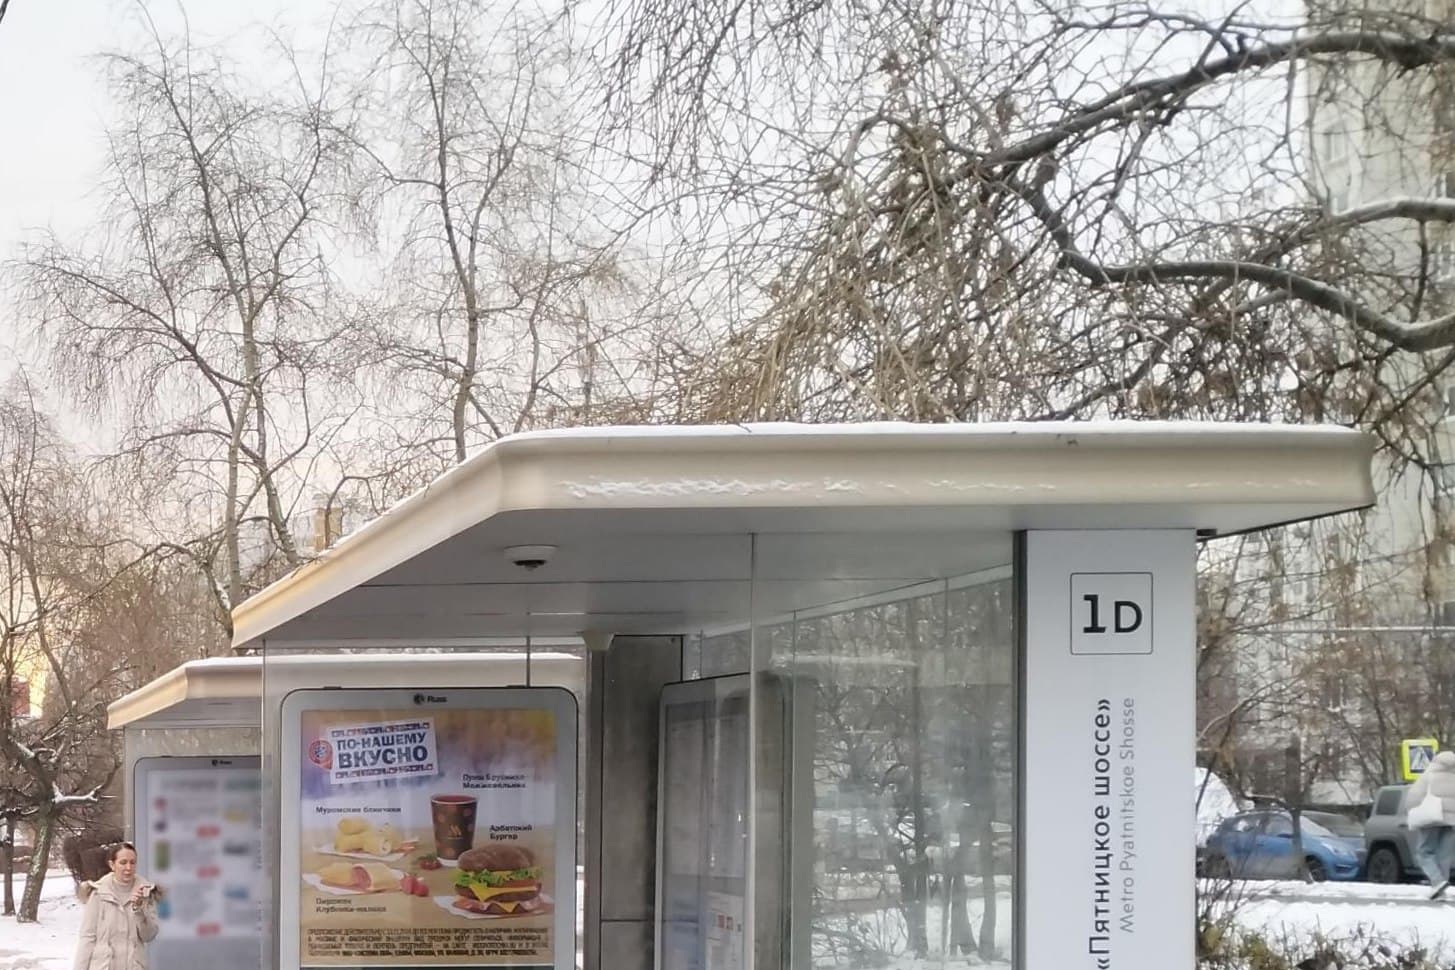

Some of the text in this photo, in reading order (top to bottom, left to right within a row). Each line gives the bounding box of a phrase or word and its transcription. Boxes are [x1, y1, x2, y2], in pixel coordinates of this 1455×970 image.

[1082, 593, 1144, 634] 1D
[337, 731, 428, 751] ПО-НАШЕМУ
[338, 745, 429, 769] ВКУСНО
[1094, 698, 1111, 796] шоссе»
[1119, 697, 1138, 933] Metro Pyatnitskoe Shosse
[1088, 805, 1114, 970] «Пятницкое
